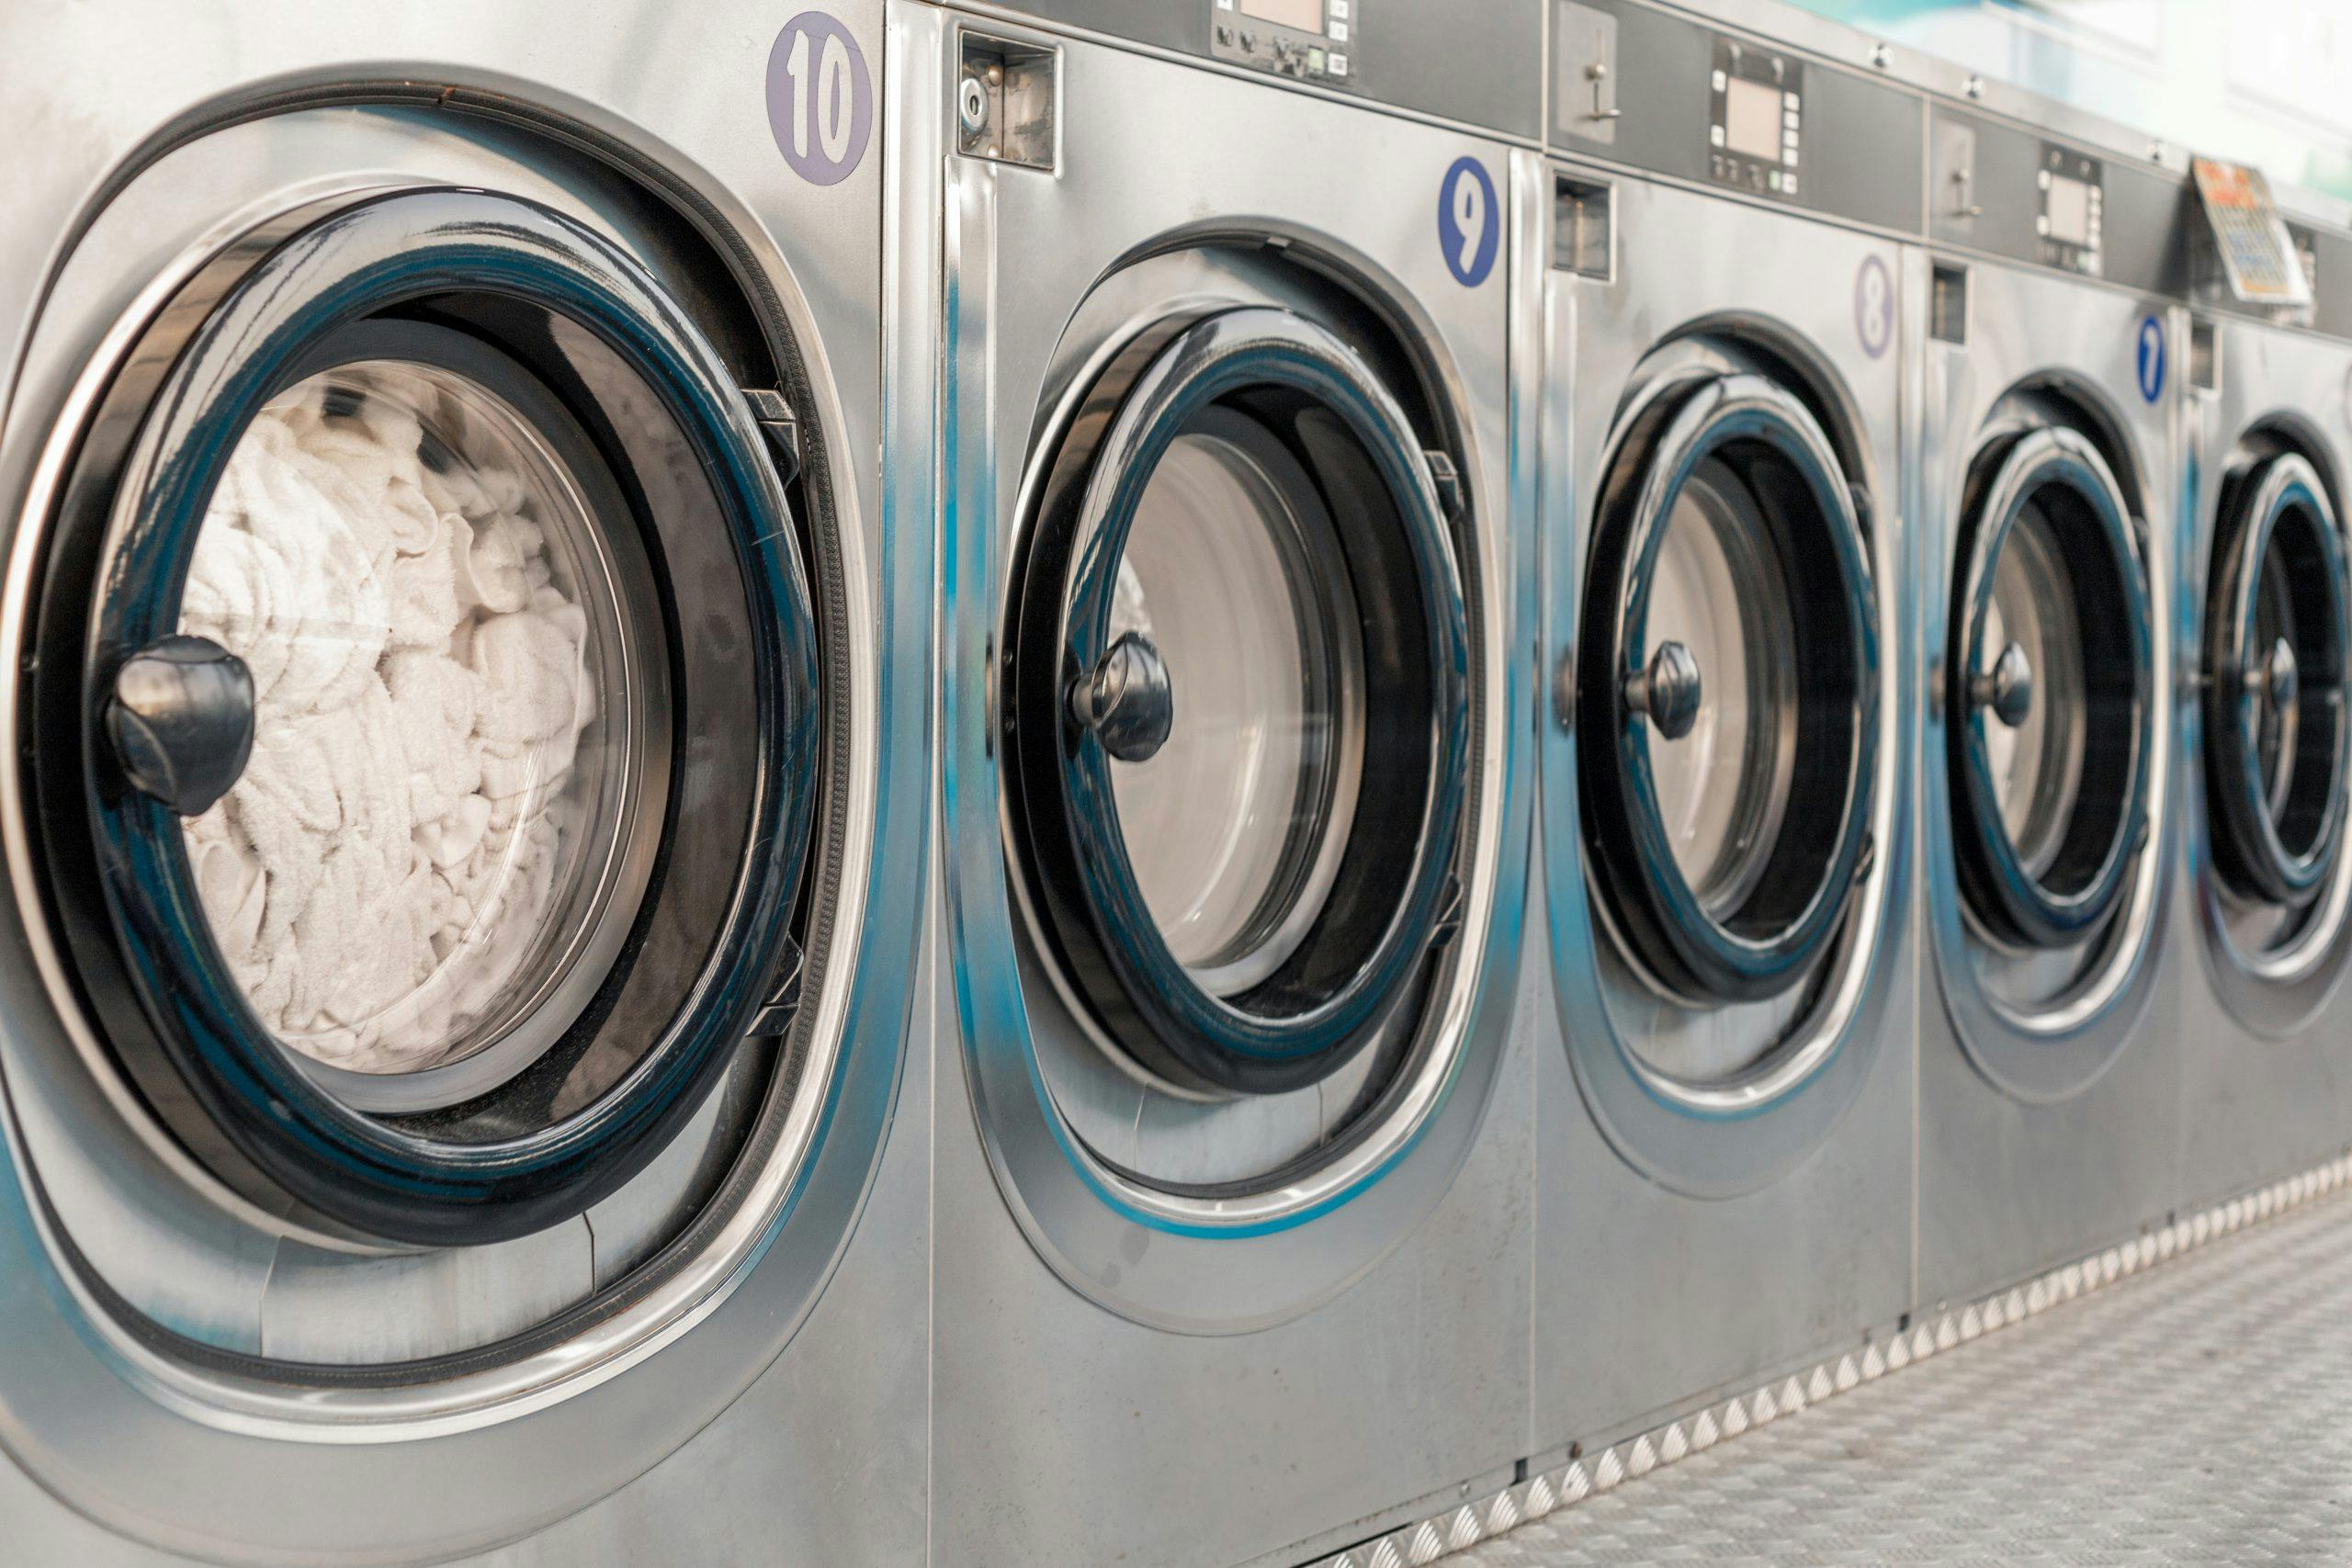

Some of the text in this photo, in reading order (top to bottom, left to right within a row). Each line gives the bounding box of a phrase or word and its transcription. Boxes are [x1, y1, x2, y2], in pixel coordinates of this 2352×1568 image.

[786, 28, 853, 164] 10
[1453, 168, 1486, 275] 9
[1863, 264, 1886, 347] 8
[2143, 325, 2159, 393] 7
